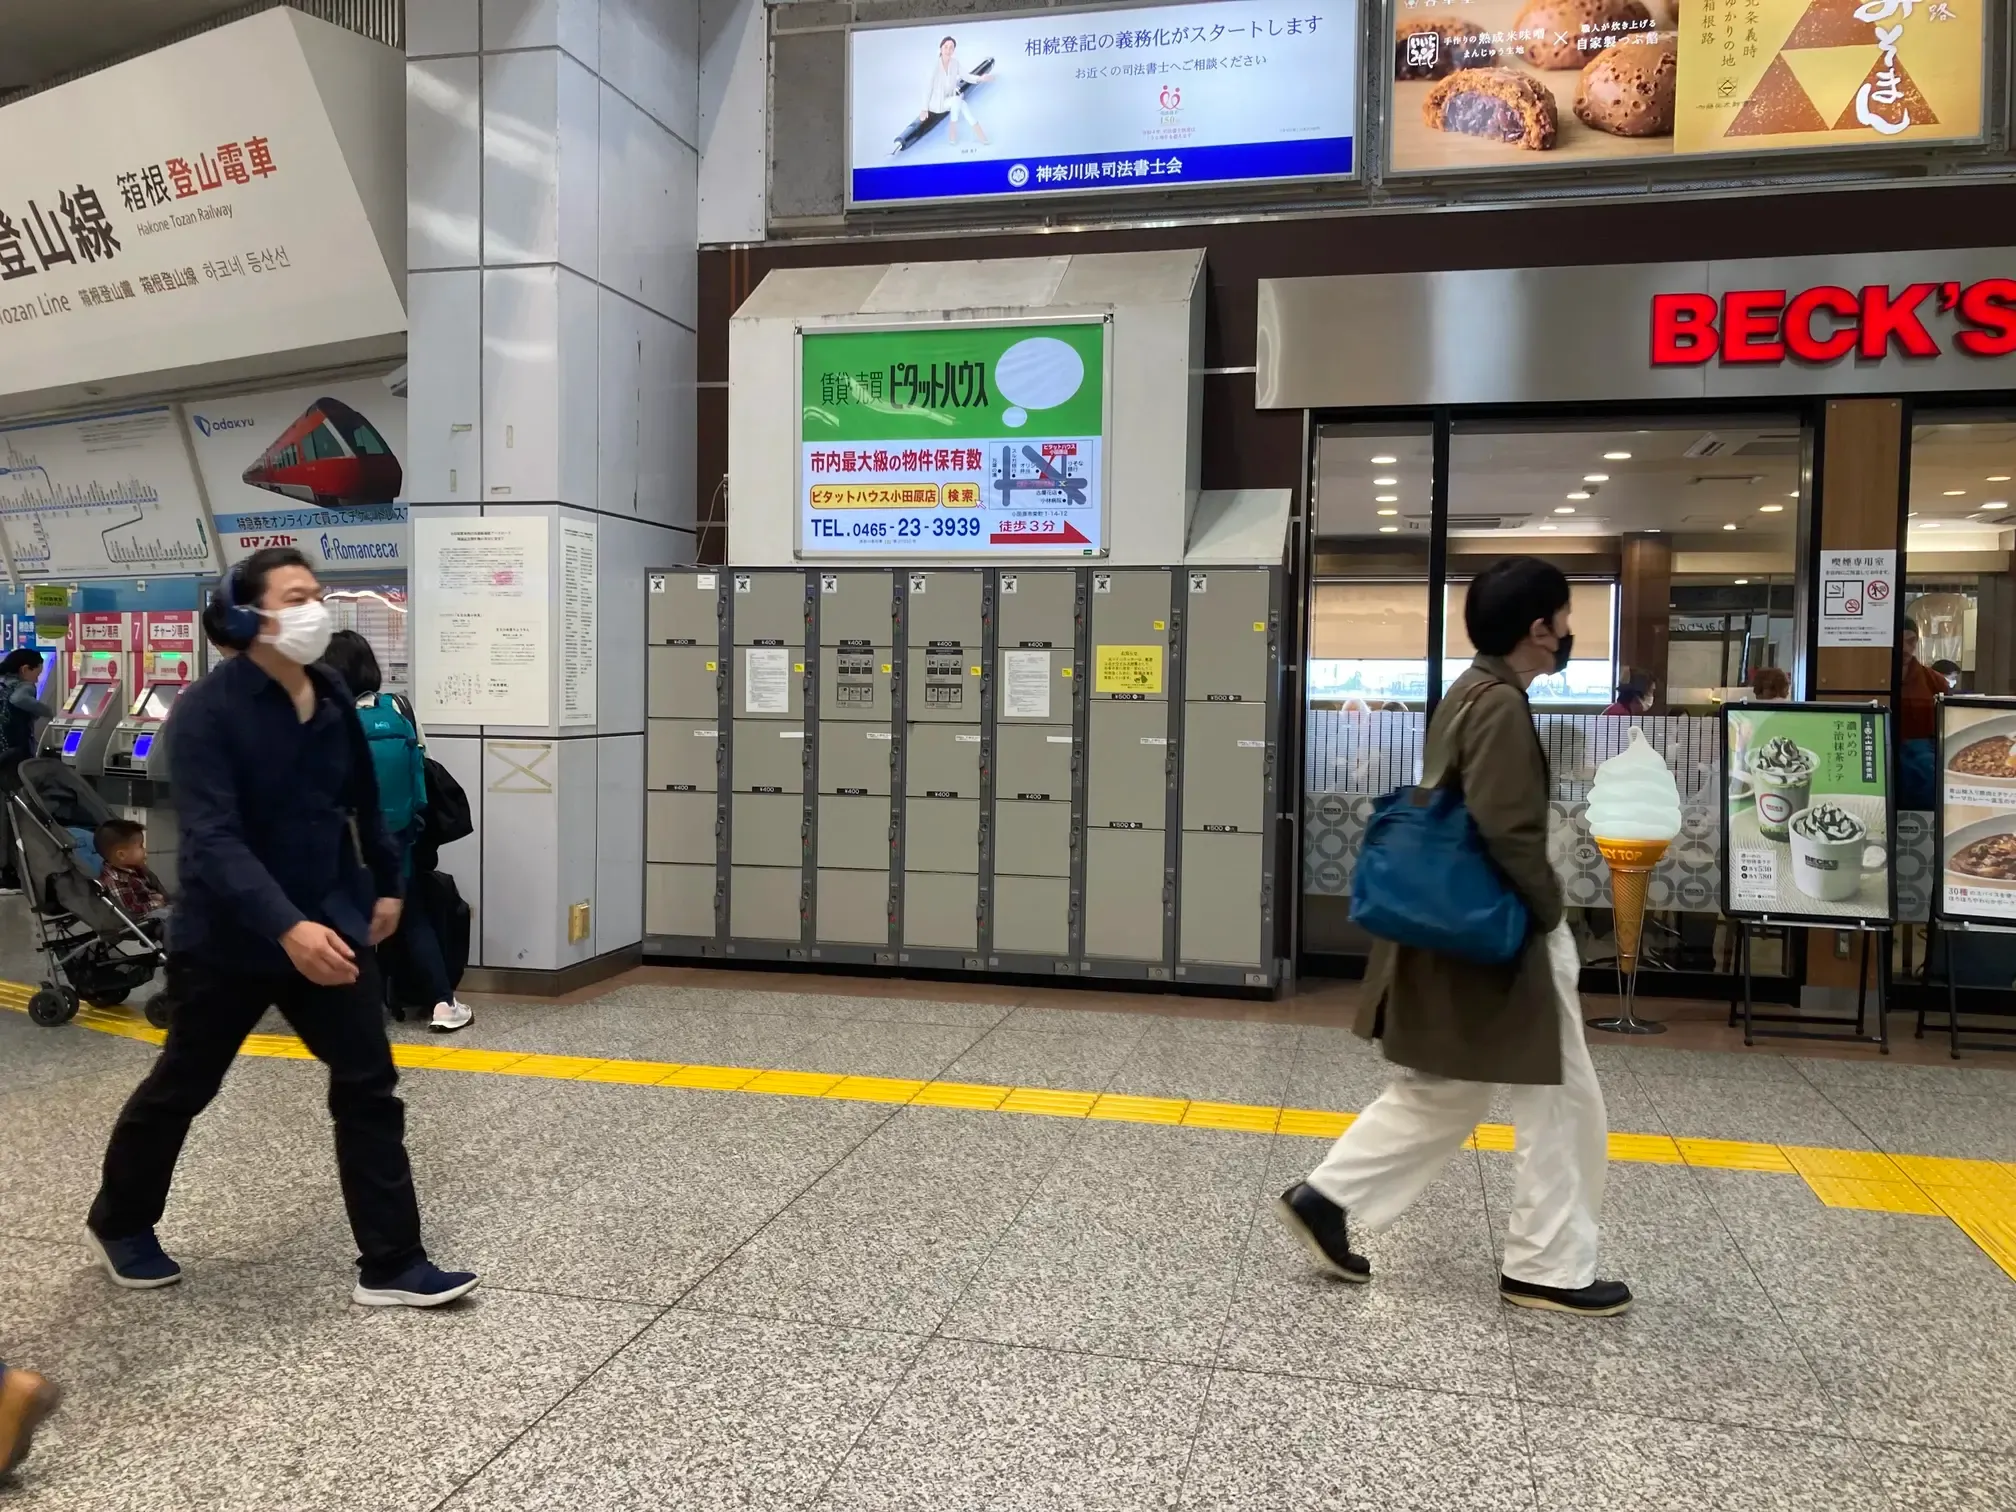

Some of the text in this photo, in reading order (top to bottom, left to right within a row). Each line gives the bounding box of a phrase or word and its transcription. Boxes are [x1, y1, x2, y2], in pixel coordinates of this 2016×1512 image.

[1024, 15, 1323, 57] 相続登記の義務化がスタートします
[1580, 19, 1657, 33] 職人が炊き上げる
[1443, 27, 1545, 46] 手作りの熟成米味噌
[1577, 31, 1658, 51] 自家製つぶ餡
[1463, 46, 1525, 59] まんじゅう生地
[1074, 55, 1267, 80] お近くの司法書士へご相談ください
[116, 136, 277, 213] 箱根登山電車
[1036, 156, 1183, 183] 神奈川県司法書士会
[136, 203, 233, 237] Hakone Tozan Railway
[202, 245, 291, 282] 하코네 등산선
[0, 292, 71, 325] ozan Line
[1650, 278, 2016, 365] BECK'S
[890, 360, 989, 409] ピタットハウス
[212, 417, 255, 431] odakyu
[810, 448, 983, 473] 市内最大級の物件保有数
[811, 489, 936, 504] ピタットハウス小田原店
[947, 489, 973, 503] 検索
[999, 520, 1056, 533] 徒歩3分
[240, 534, 298, 549] ロマンスカー
[1831, 557, 1884, 566] 喫煙専用室
[5, 623, 12, 640] 5
[134, 621, 141, 640] 7
[1846, 720, 1858, 757] 濃いめの
[1833, 720, 1845, 782] 宇治抹茶ラテ
[1618, 849, 1642, 861] TOP
